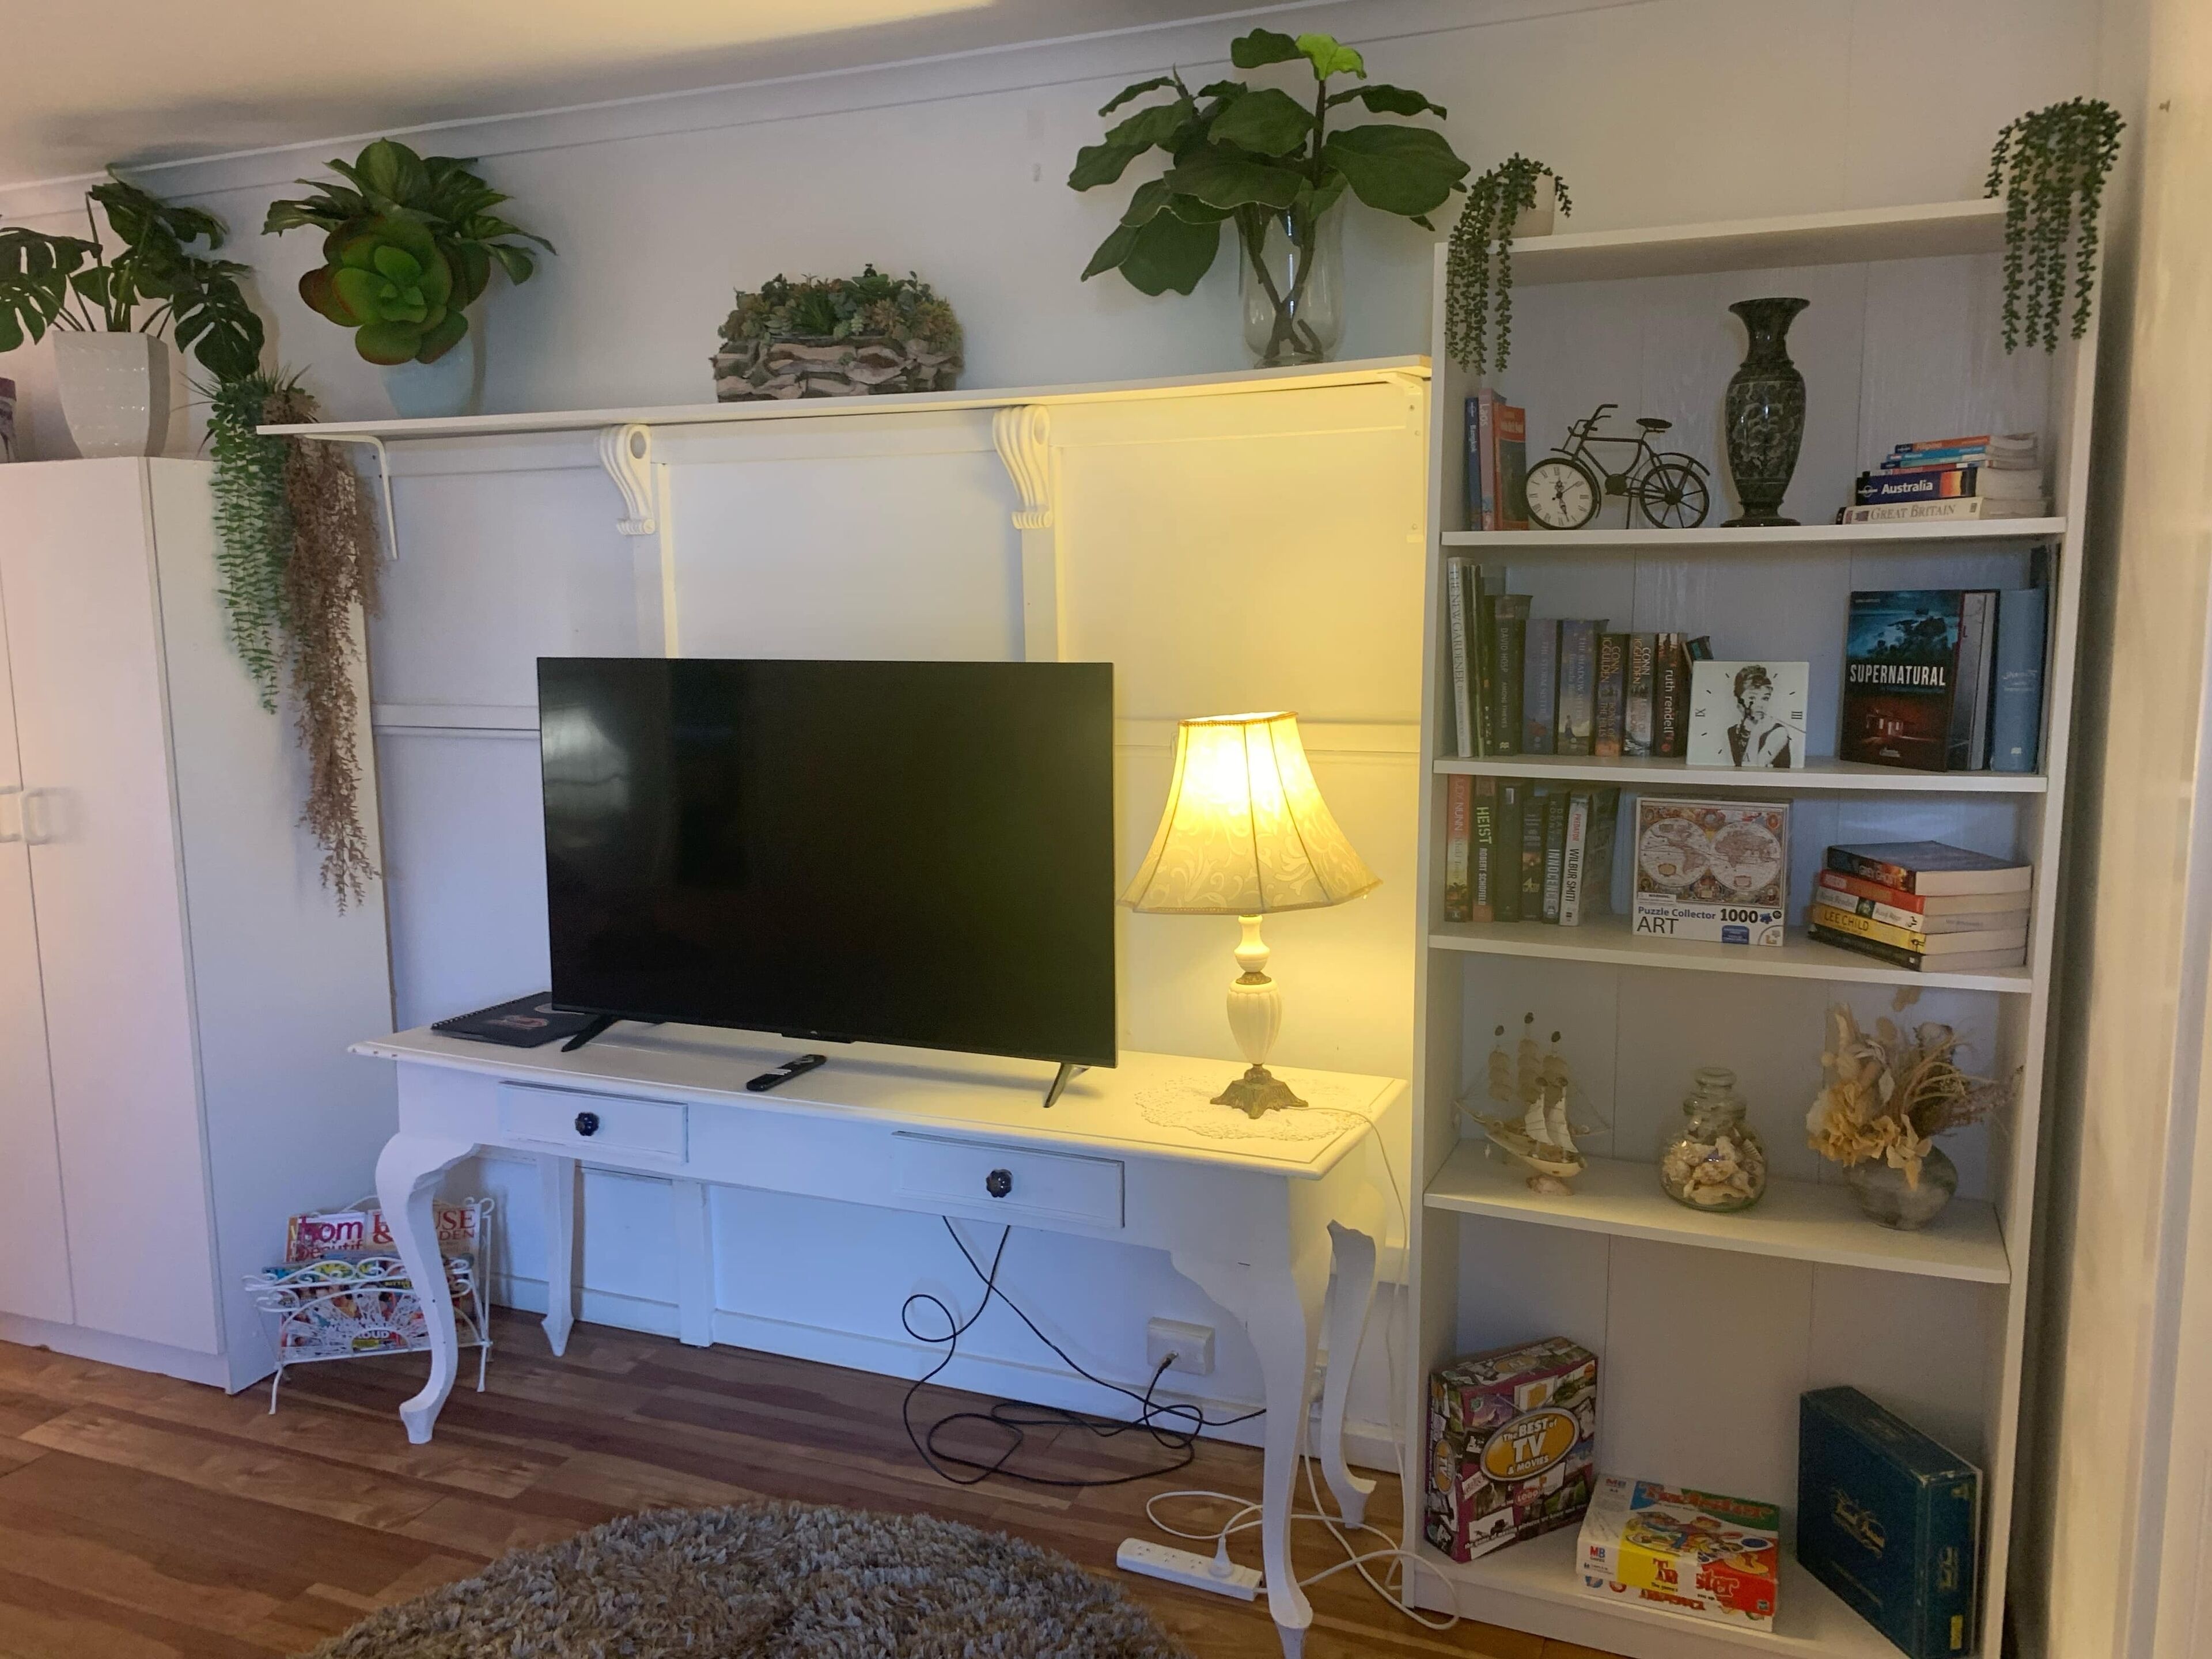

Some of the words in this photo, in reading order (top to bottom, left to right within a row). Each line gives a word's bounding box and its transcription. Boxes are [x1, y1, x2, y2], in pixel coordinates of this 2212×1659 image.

[1479, 403, 1490, 426] Laos
[1881, 479, 1933, 495] Australia
[1870, 507, 1908, 521] GREAT
[1911, 505, 1956, 517] BRITAIN
[1450, 571, 1460, 593] THE
[1451, 594, 1462, 622] NEW
[1500, 627, 1508, 651] DAVID
[1452, 622, 1464, 684] GARDENER
[1601, 637, 1611, 683] IGGULDEN
[1611, 646, 1620, 674] CONN
[1632, 638, 1642, 684] IGGULDEN
[1642, 646, 1652, 676] CONN
[1665, 669, 1675, 692] ruth
[1850, 664, 1946, 687] SUPERNATURAL
[1608, 702, 1616, 726] BONES
[1663, 696, 1674, 733] rendell
[1598, 717, 1607, 738] HILLS
[1454, 801, 1464, 831] NUNN
[1476, 806, 1492, 844] HEIST
[1479, 847, 1487, 872] ROBERT
[1567, 849, 1580, 879] WILBUR
[1546, 849, 1560, 903] INNOCENCE
[1478, 873, 1487, 906] SCHOFIELD
[1637, 916, 1679, 934] ART
[1638, 906, 1669, 916] Puzzle
[1671, 909, 1716, 920] Collector
[1720, 908, 1759, 923] 1000
[1824, 910, 1841, 923] LEE
[1841, 914, 1869, 931] CHILD
[301, 1215, 363, 1243] hom
[1518, 1418, 1549, 1437] BEST
[1548, 1418, 1558, 1427] of
[1512, 1430, 1547, 1463] TV
[1507, 1466, 1514, 1475] &
[1517, 1455, 1549, 1472] MOVIES
[1590, 1545, 1606, 1558] MB
